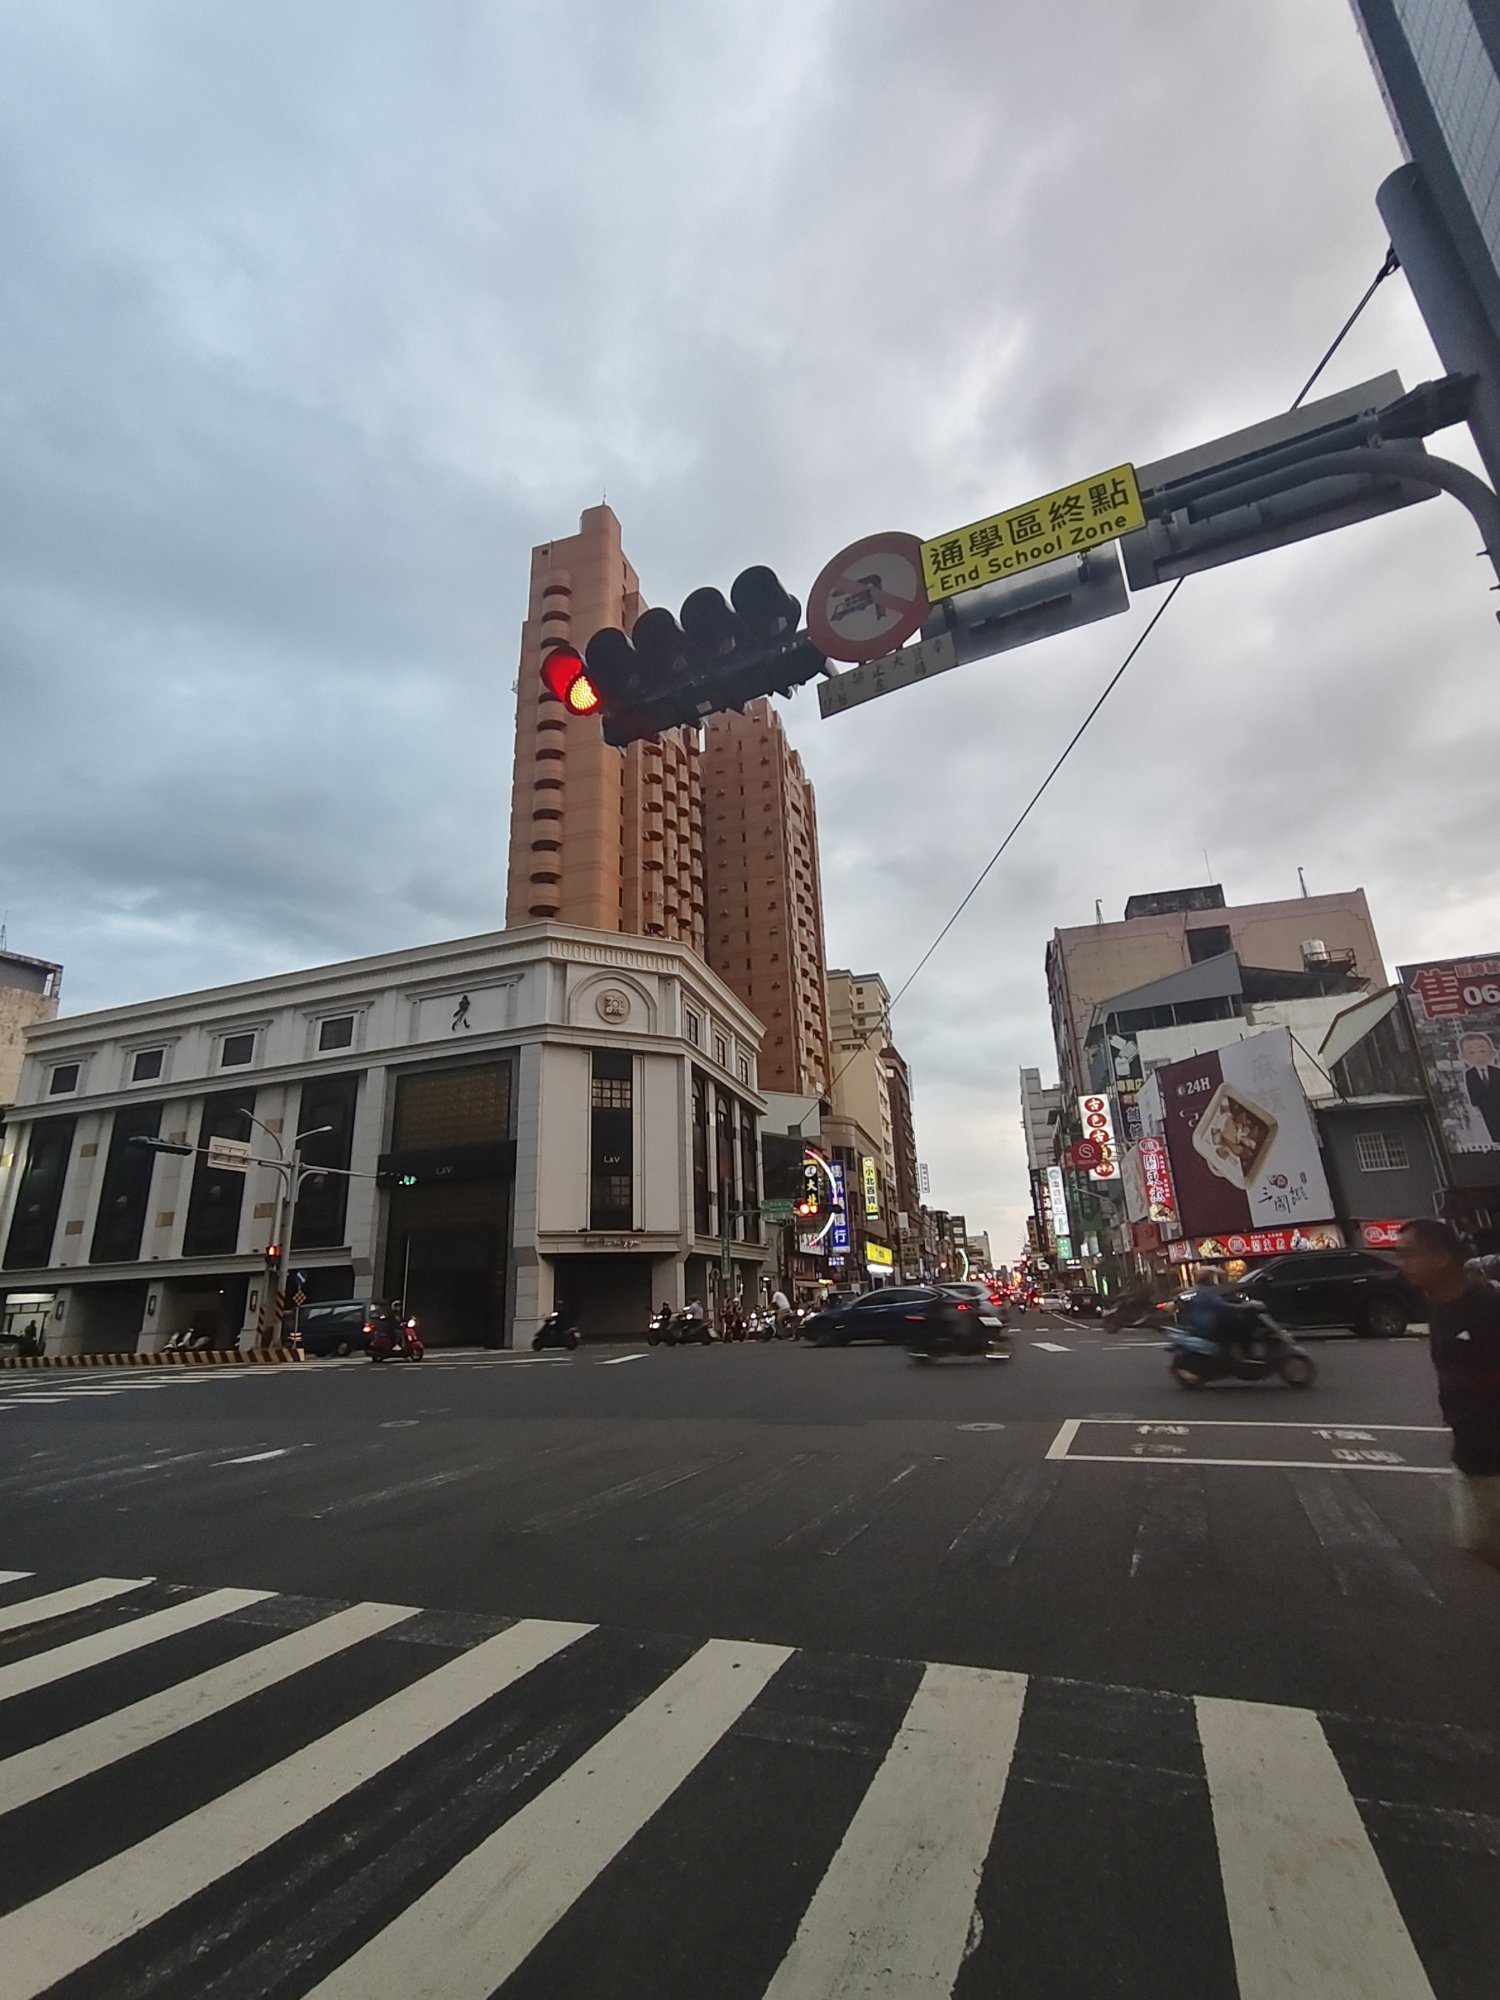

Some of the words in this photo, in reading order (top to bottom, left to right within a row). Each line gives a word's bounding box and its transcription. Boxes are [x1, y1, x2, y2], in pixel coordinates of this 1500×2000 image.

[929, 477, 1129, 576] 通學區終點
[940, 566, 980, 593] End
[988, 535, 1063, 574] School
[1071, 513, 1127, 544] Zone
[1411, 968, 1468, 1020] 售
[1186, 1078, 1211, 1096] 24H
[865, 1168, 876, 1204] 小北百貨
